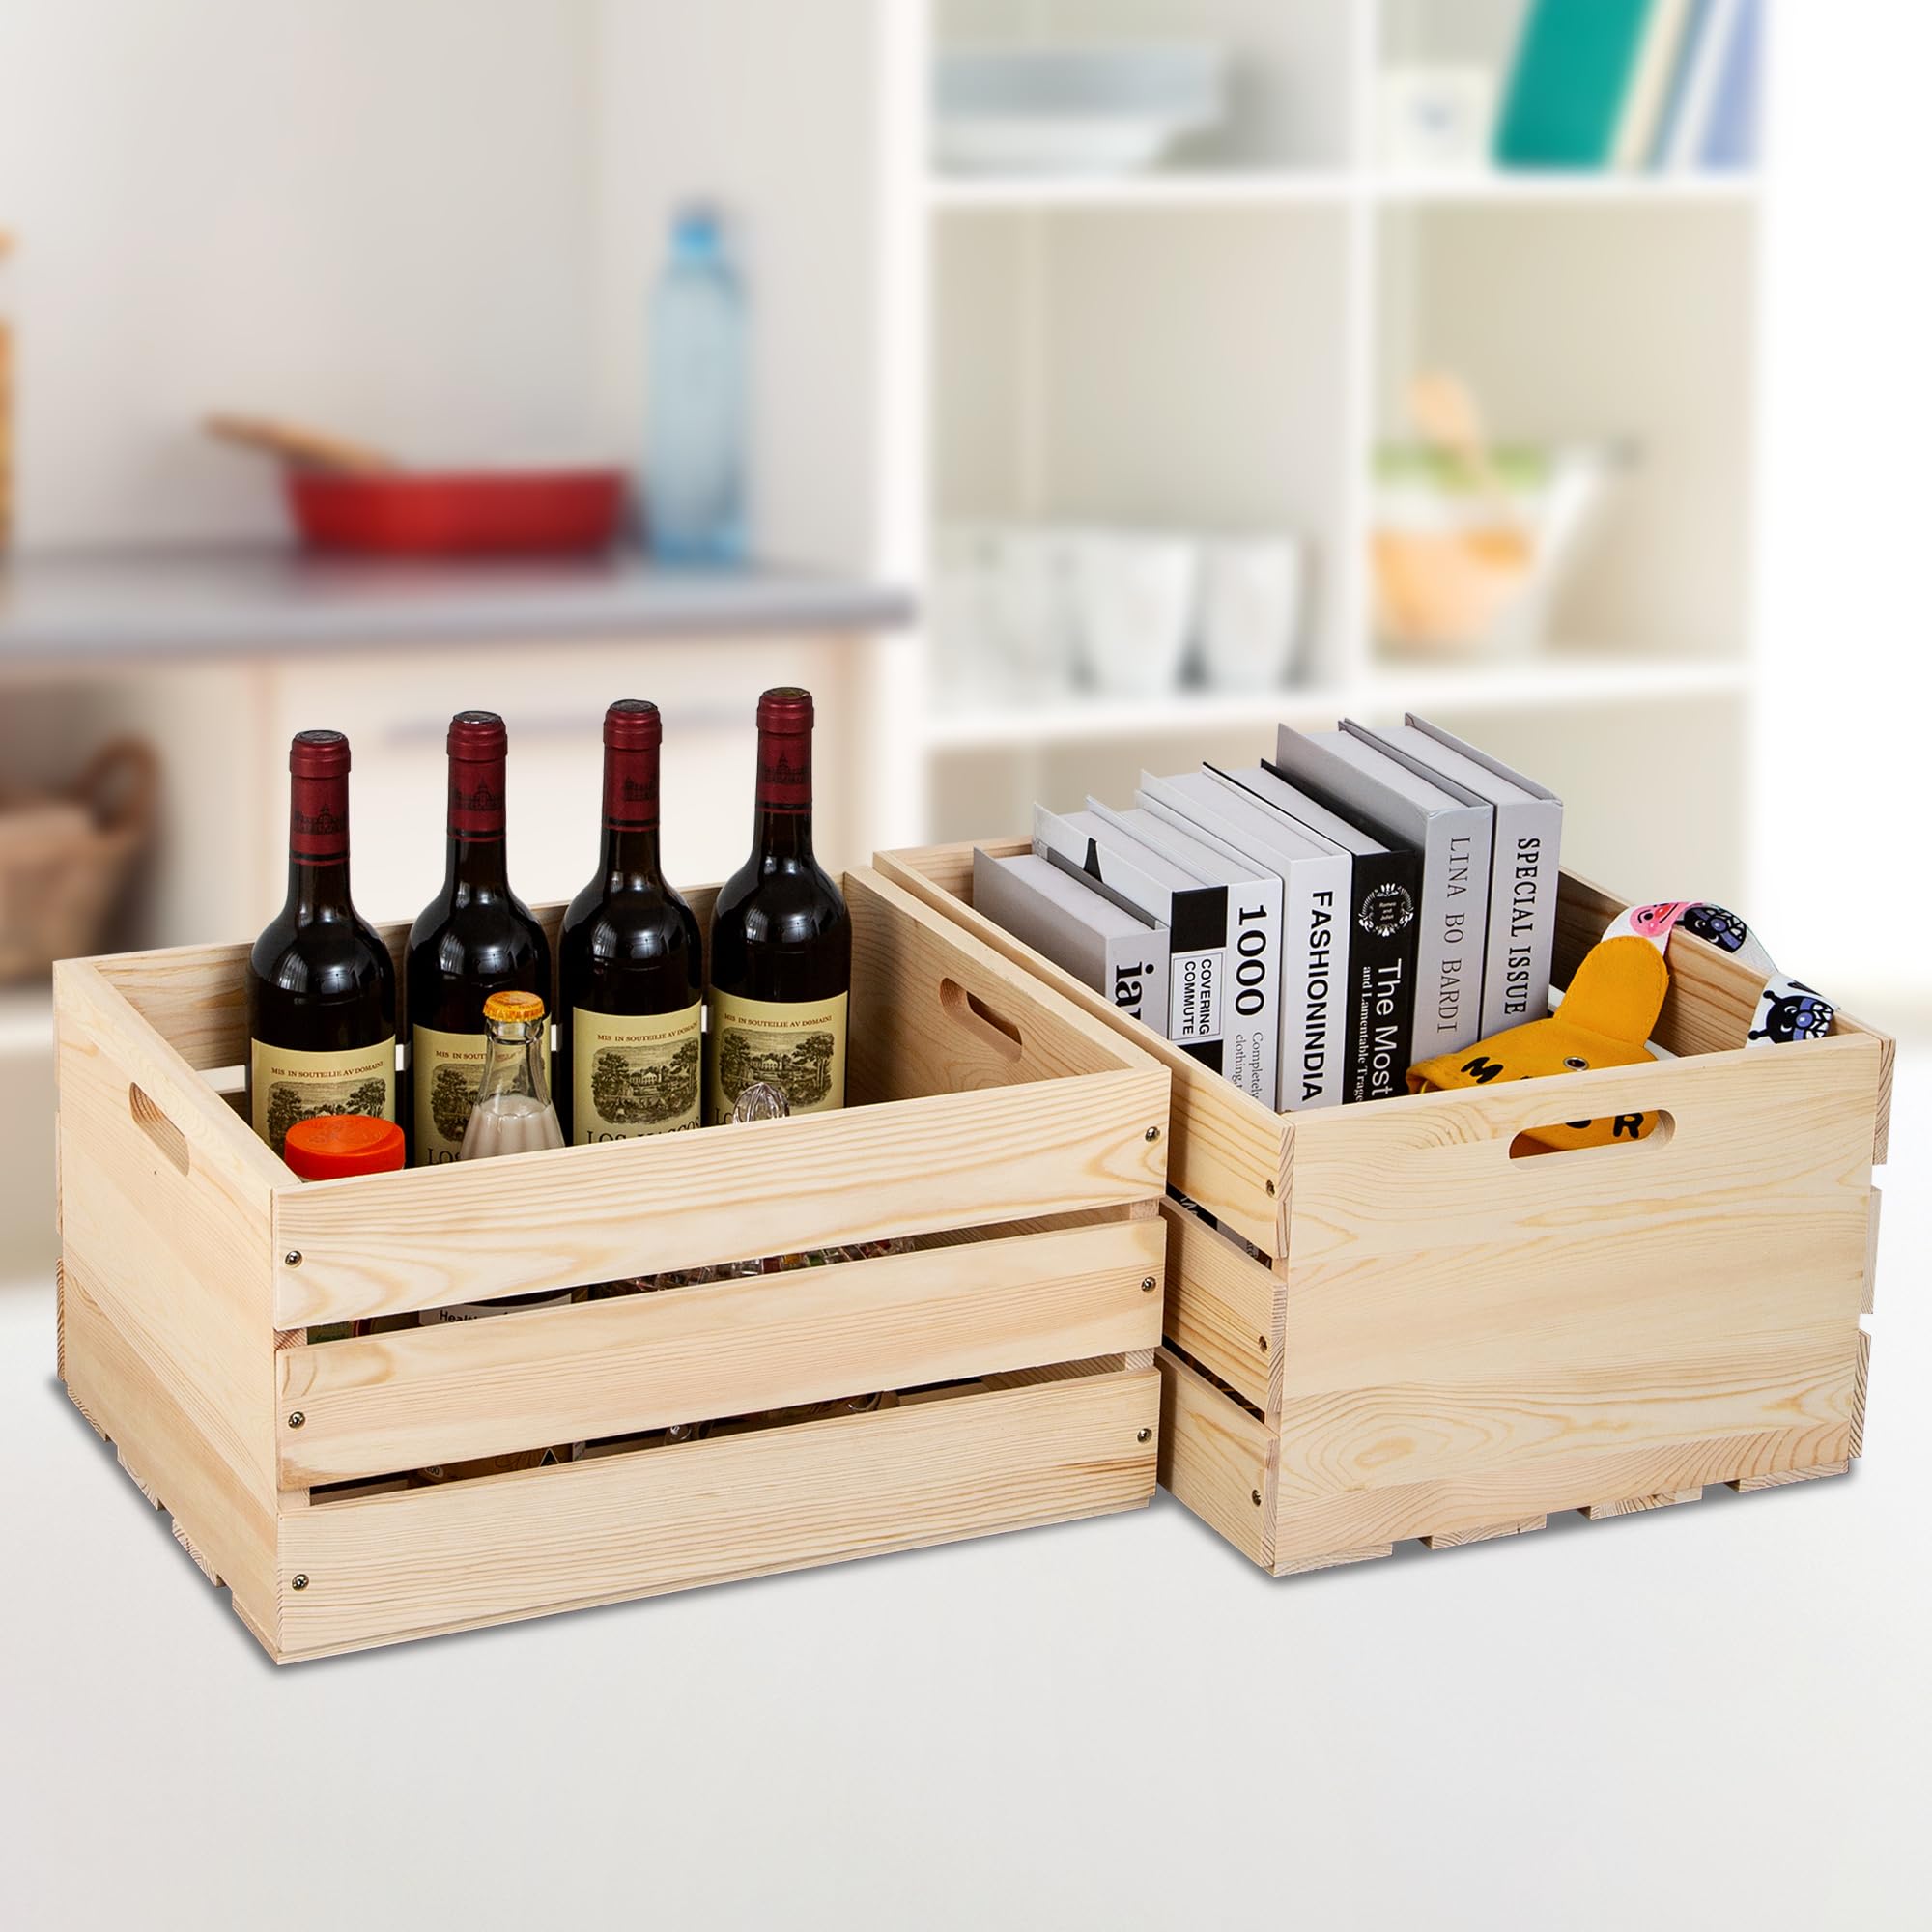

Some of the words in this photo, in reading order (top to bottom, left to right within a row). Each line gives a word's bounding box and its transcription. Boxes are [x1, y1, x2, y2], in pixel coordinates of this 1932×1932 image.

[1446, 836, 1471, 898] LINA
[1510, 838, 1541, 938] SPECIAL
[1235, 904, 1267, 1016] 1000
[1443, 912, 1465, 944] BO
[1182, 960, 1196, 1035] COMMUTE
[1198, 958, 1212, 1035] COVERING
[1301, 890, 1334, 1102] FASHIONINDIA
[1361, 966, 1373, 989] and
[1375, 957, 1402, 1016] The
[1436, 957, 1463, 1034] BARDI
[1504, 945, 1532, 1015] ISSUE
[453, 1051, 462, 1060] IN
[463, 1052, 487, 1061] SOUT
[1357, 992, 1372, 1064] Lamentable
[1371, 1025, 1399, 1097] Most
[271, 1067, 285, 1076] MIS
[1249, 1031, 1264, 1099] Completely
